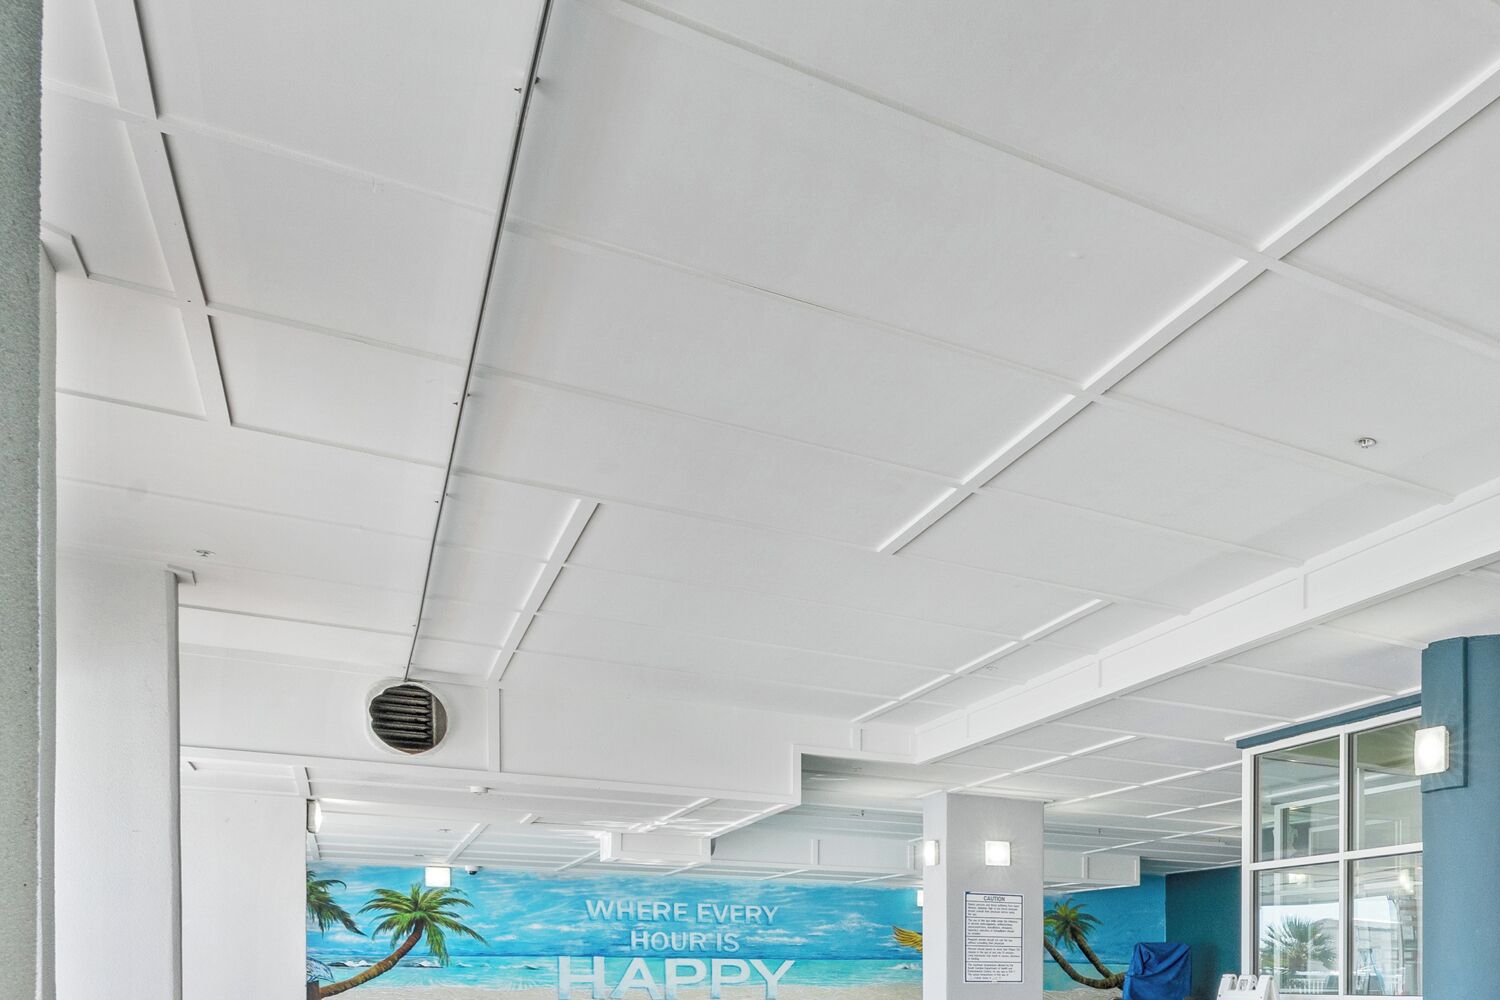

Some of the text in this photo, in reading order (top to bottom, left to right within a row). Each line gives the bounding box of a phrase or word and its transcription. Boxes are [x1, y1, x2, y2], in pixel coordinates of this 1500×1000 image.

[586, 900, 779, 925] WHERE EVERY
[630, 930, 740, 953] HOUR IS
[558, 955, 796, 1000] HAPPY
